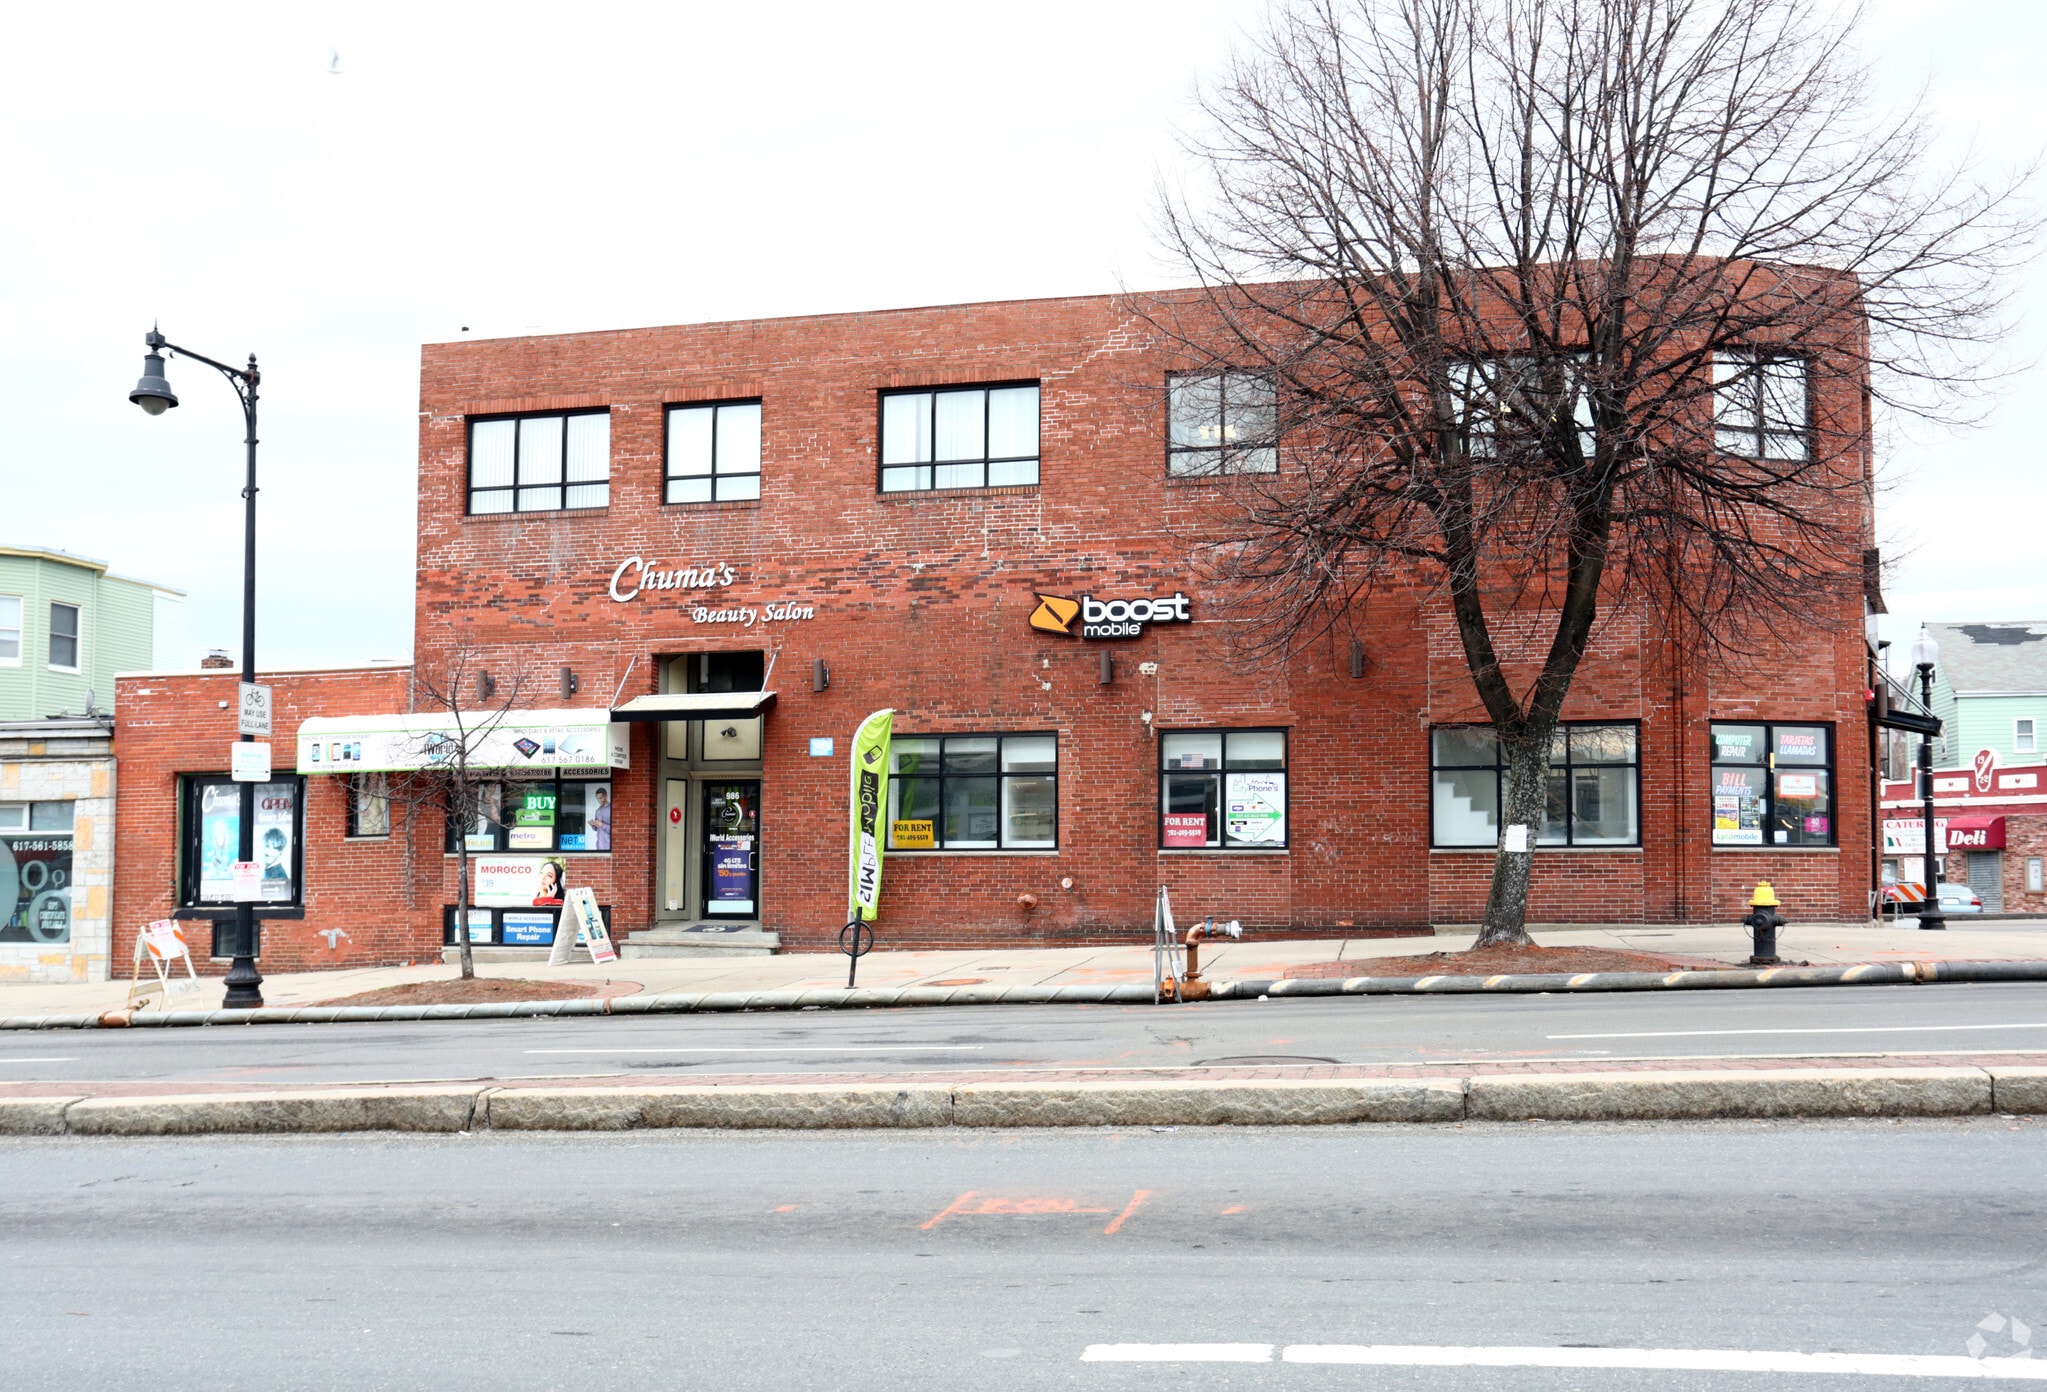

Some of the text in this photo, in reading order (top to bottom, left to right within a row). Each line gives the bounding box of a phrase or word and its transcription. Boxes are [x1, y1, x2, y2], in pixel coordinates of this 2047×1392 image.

[609, 556, 736, 602] Chuma's
[1083, 592, 1190, 623] boost
[692, 601, 815, 627] Beauty Salon
[1084, 622, 1140, 637] mobile
[244, 708, 267, 719] MAY USE
[241, 720, 269, 730] FULL LANE
[1715, 734, 1752, 746] COMPUTER
[1780, 734, 1815, 746] TARJETAS
[1721, 746, 1747, 757] REPAIR
[1779, 745, 1817, 755] LLAMADAS
[558, 755, 573, 763] 567
[575, 755, 595, 763] 0186
[563, 768, 609, 776] ACCESSORIES
[1722, 772, 1746, 786] BILL
[1715, 785, 1753, 795] PAYMENTS
[726, 791, 740, 800] 986
[261, 798, 293, 810] OPEN
[526, 796, 556, 810] BUY
[1164, 817, 1205, 827] FOR RENT
[1886, 820, 1944, 828] CATERG
[894, 823, 932, 832] FOR RENT
[1716, 832, 1758, 842] Lycamobile
[1948, 830, 1986, 846] Deli
[481, 866, 532, 874] MOROCCO
[506, 925, 551, 934] Smart Phone
[516, 933, 541, 942] Repair
